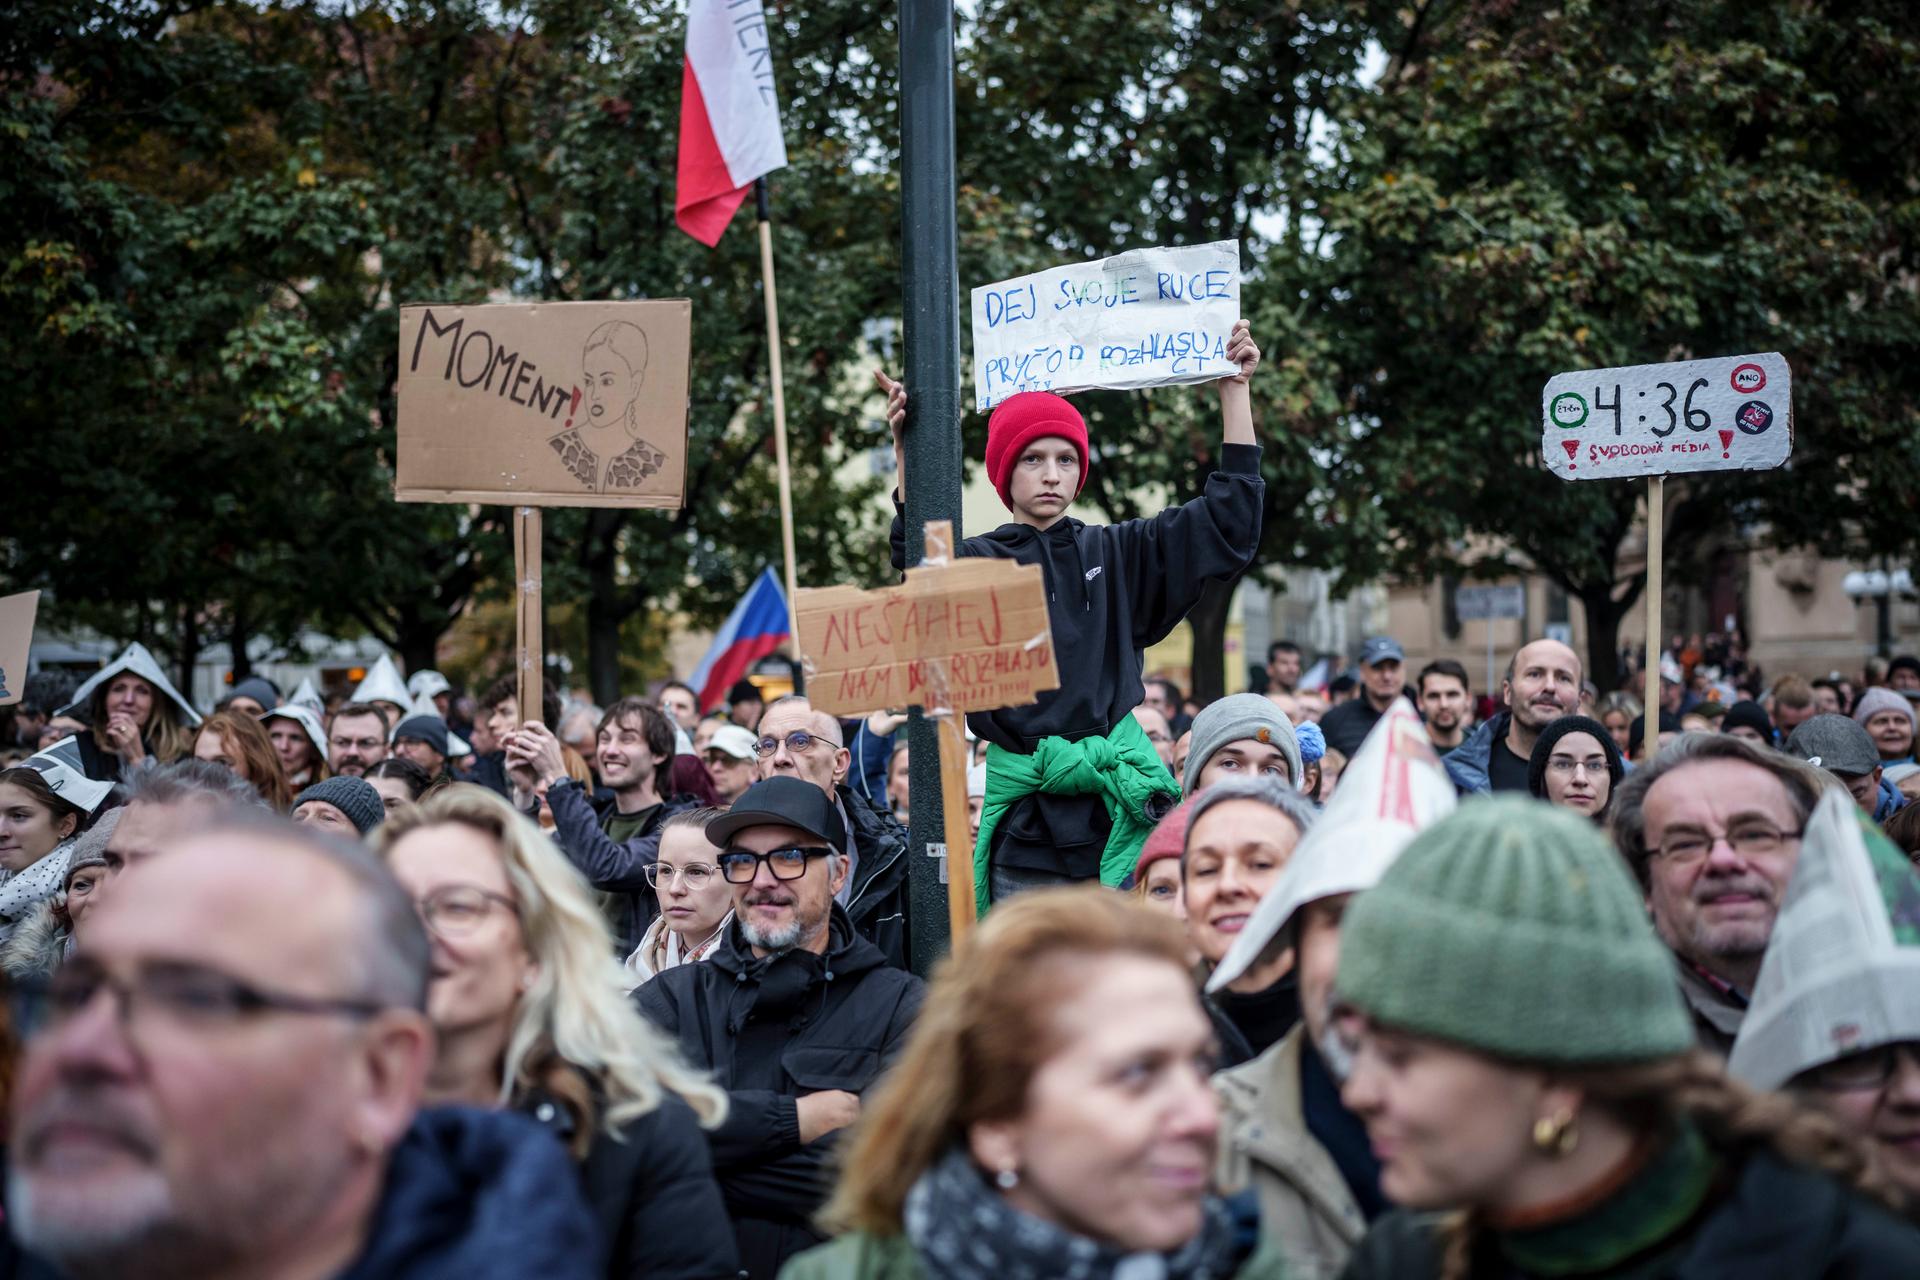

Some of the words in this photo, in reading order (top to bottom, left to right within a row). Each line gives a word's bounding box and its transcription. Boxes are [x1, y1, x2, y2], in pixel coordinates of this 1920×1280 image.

[985, 283, 1036, 328] DEJ
[1054, 277, 1140, 311] SVOJE
[1157, 270, 1232, 301] RUCE
[410, 308, 583, 428] MOMENT!
[1212, 336, 1225, 360] A
[1738, 373, 1760, 384] ANO
[1594, 377, 1712, 438] 4:36
[1671, 439, 1711, 454] MÉDIA
[822, 584, 1004, 657] NEŠAHEJ
[837, 655, 893, 702] NÁM
